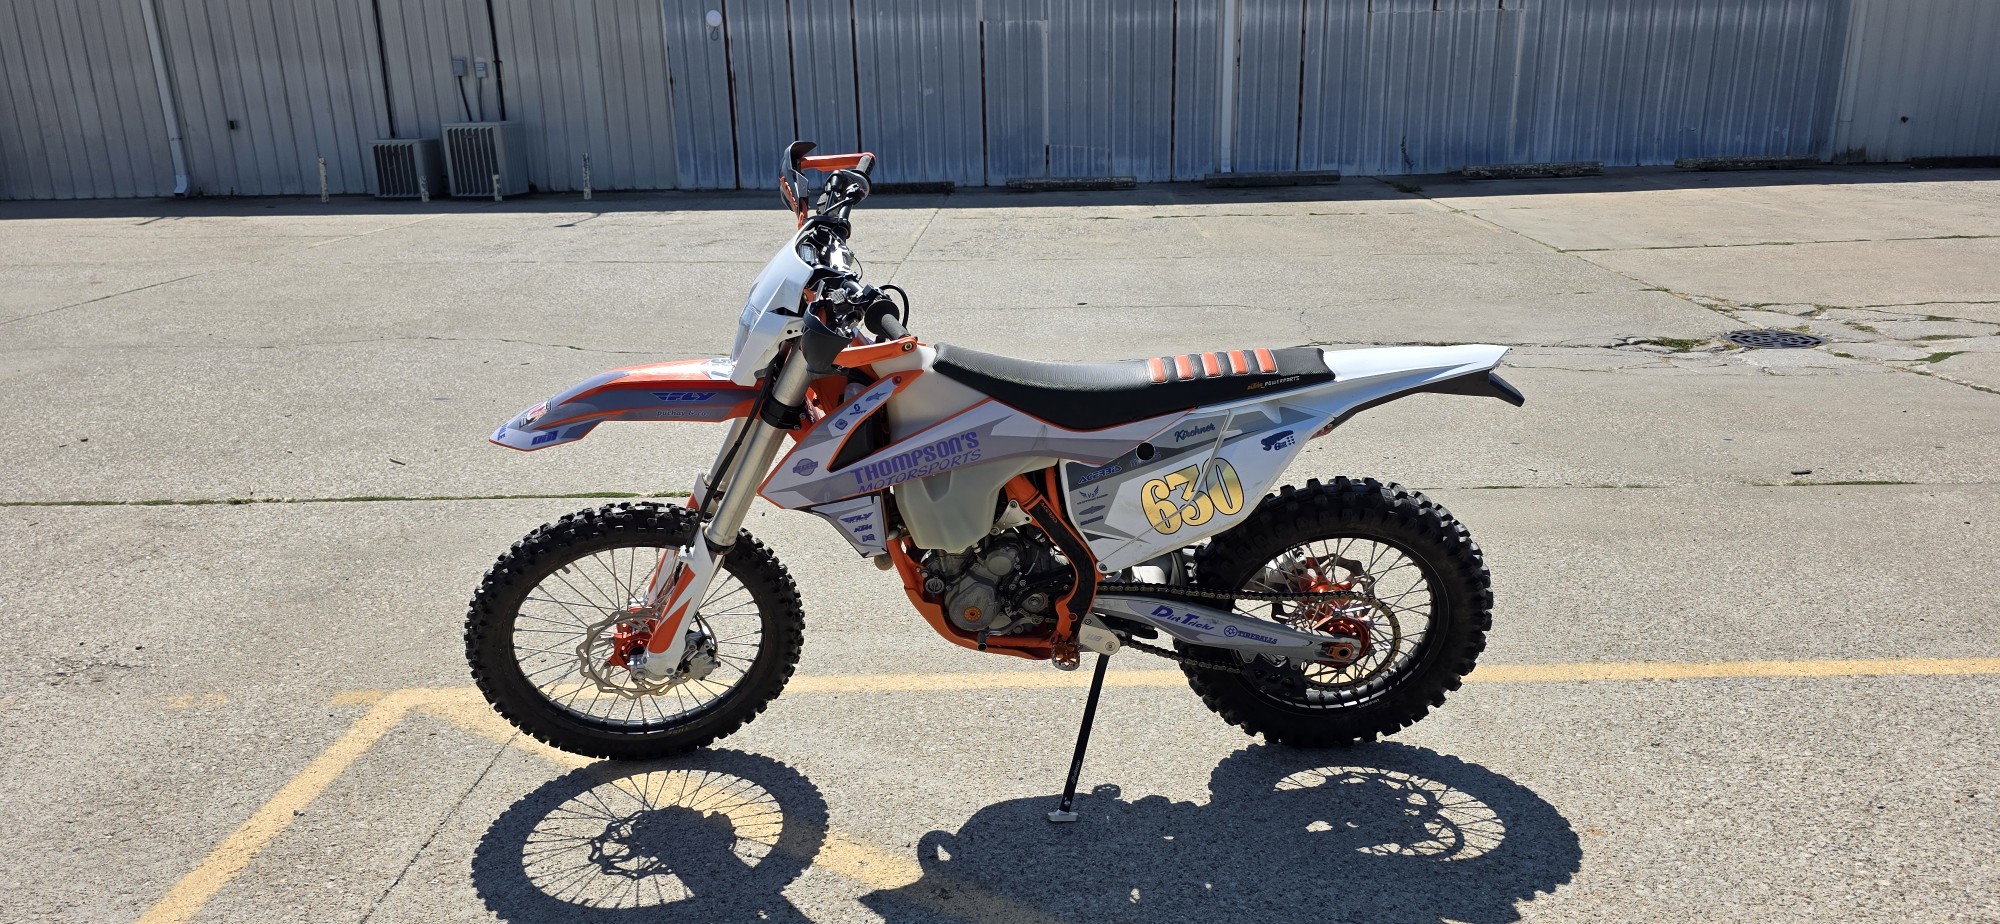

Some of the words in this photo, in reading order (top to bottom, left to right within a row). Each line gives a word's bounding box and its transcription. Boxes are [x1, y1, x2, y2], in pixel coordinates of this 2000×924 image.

[651, 391, 718, 401] FLY
[1174, 422, 1216, 443] Kirchner
[850, 431, 980, 485] THOMPSON'S
[858, 448, 982, 493] MOTORSPORTS
[1078, 464, 1123, 485] ACERBIS
[1140, 457, 1245, 535] 630
[1237, 630, 1279, 645] TIREBALLS
